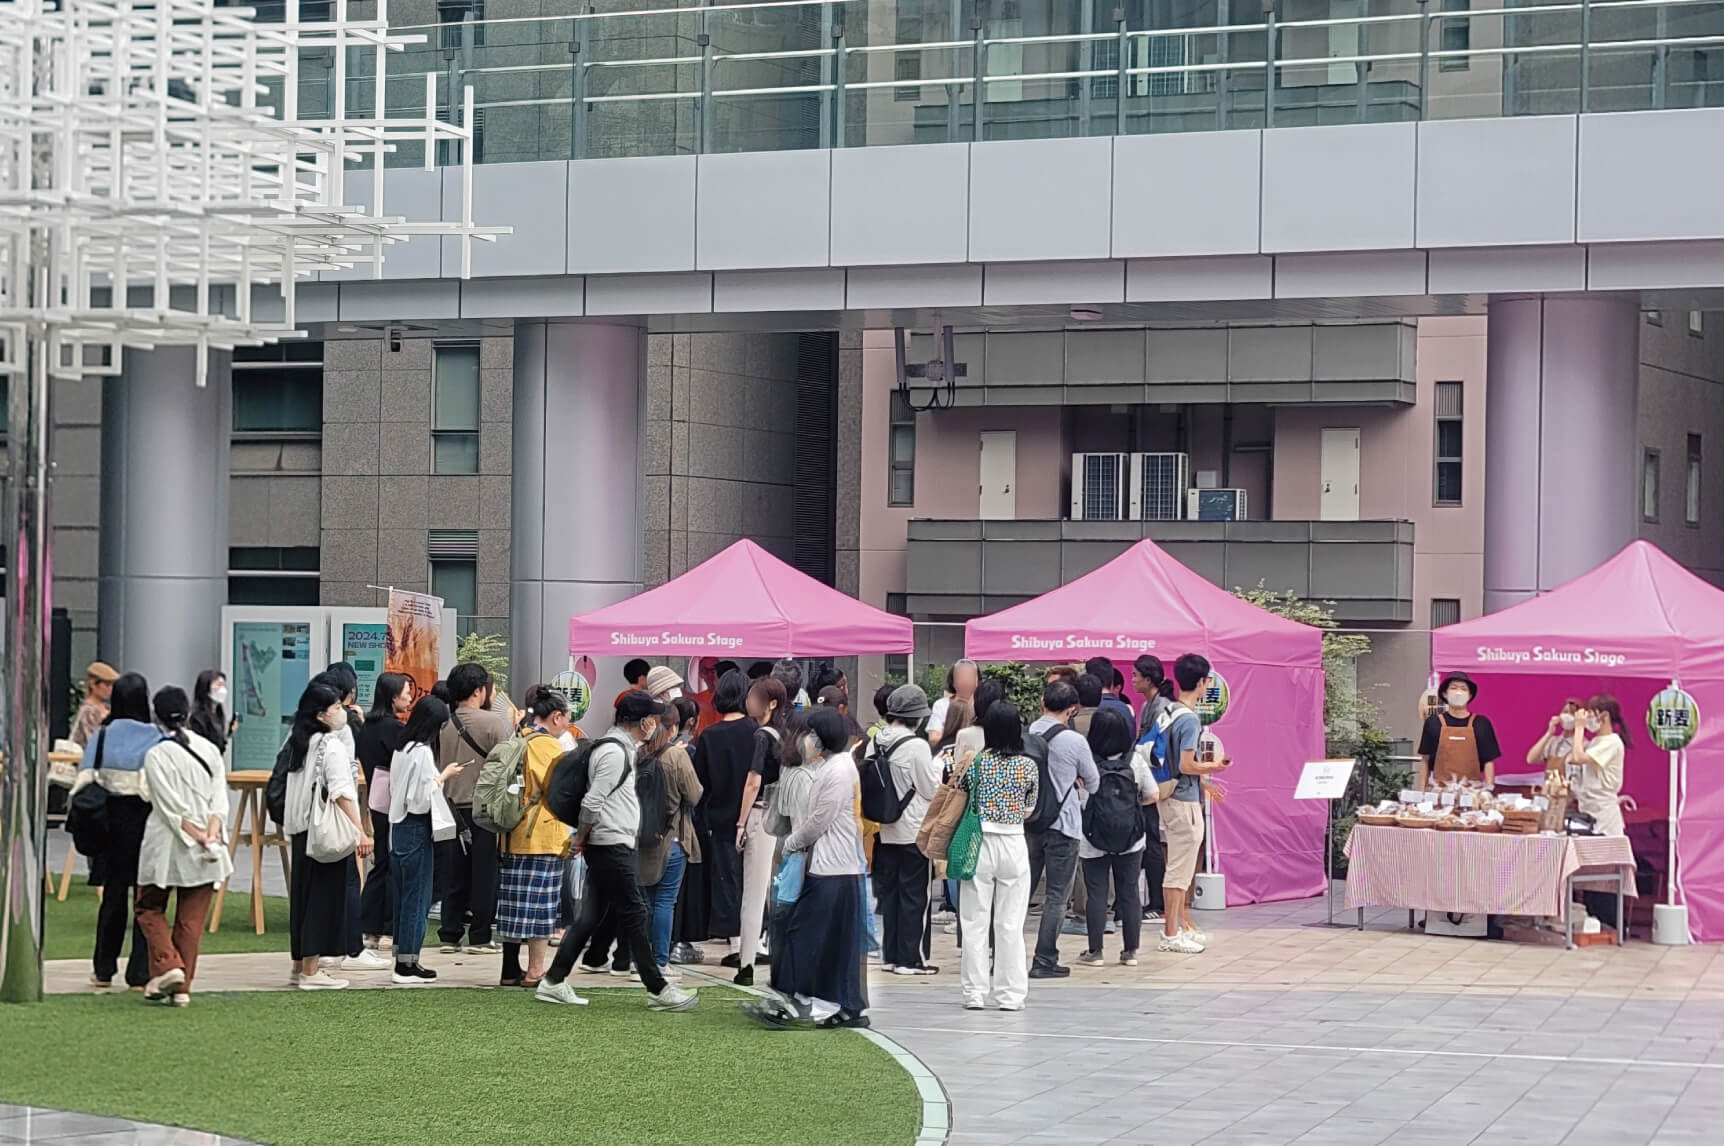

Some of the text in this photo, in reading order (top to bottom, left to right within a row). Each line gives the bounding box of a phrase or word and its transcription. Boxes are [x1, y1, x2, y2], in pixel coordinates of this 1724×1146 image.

[348, 641, 366, 649] NEW
[610, 632, 743, 648] Shibuya Sakura Stage
[1011, 634, 1156, 651] Shibuya Sakura Stage
[1477, 646, 1625, 667] Shibuya Sakura Stage
[1655, 708, 1689, 727] 新麦
